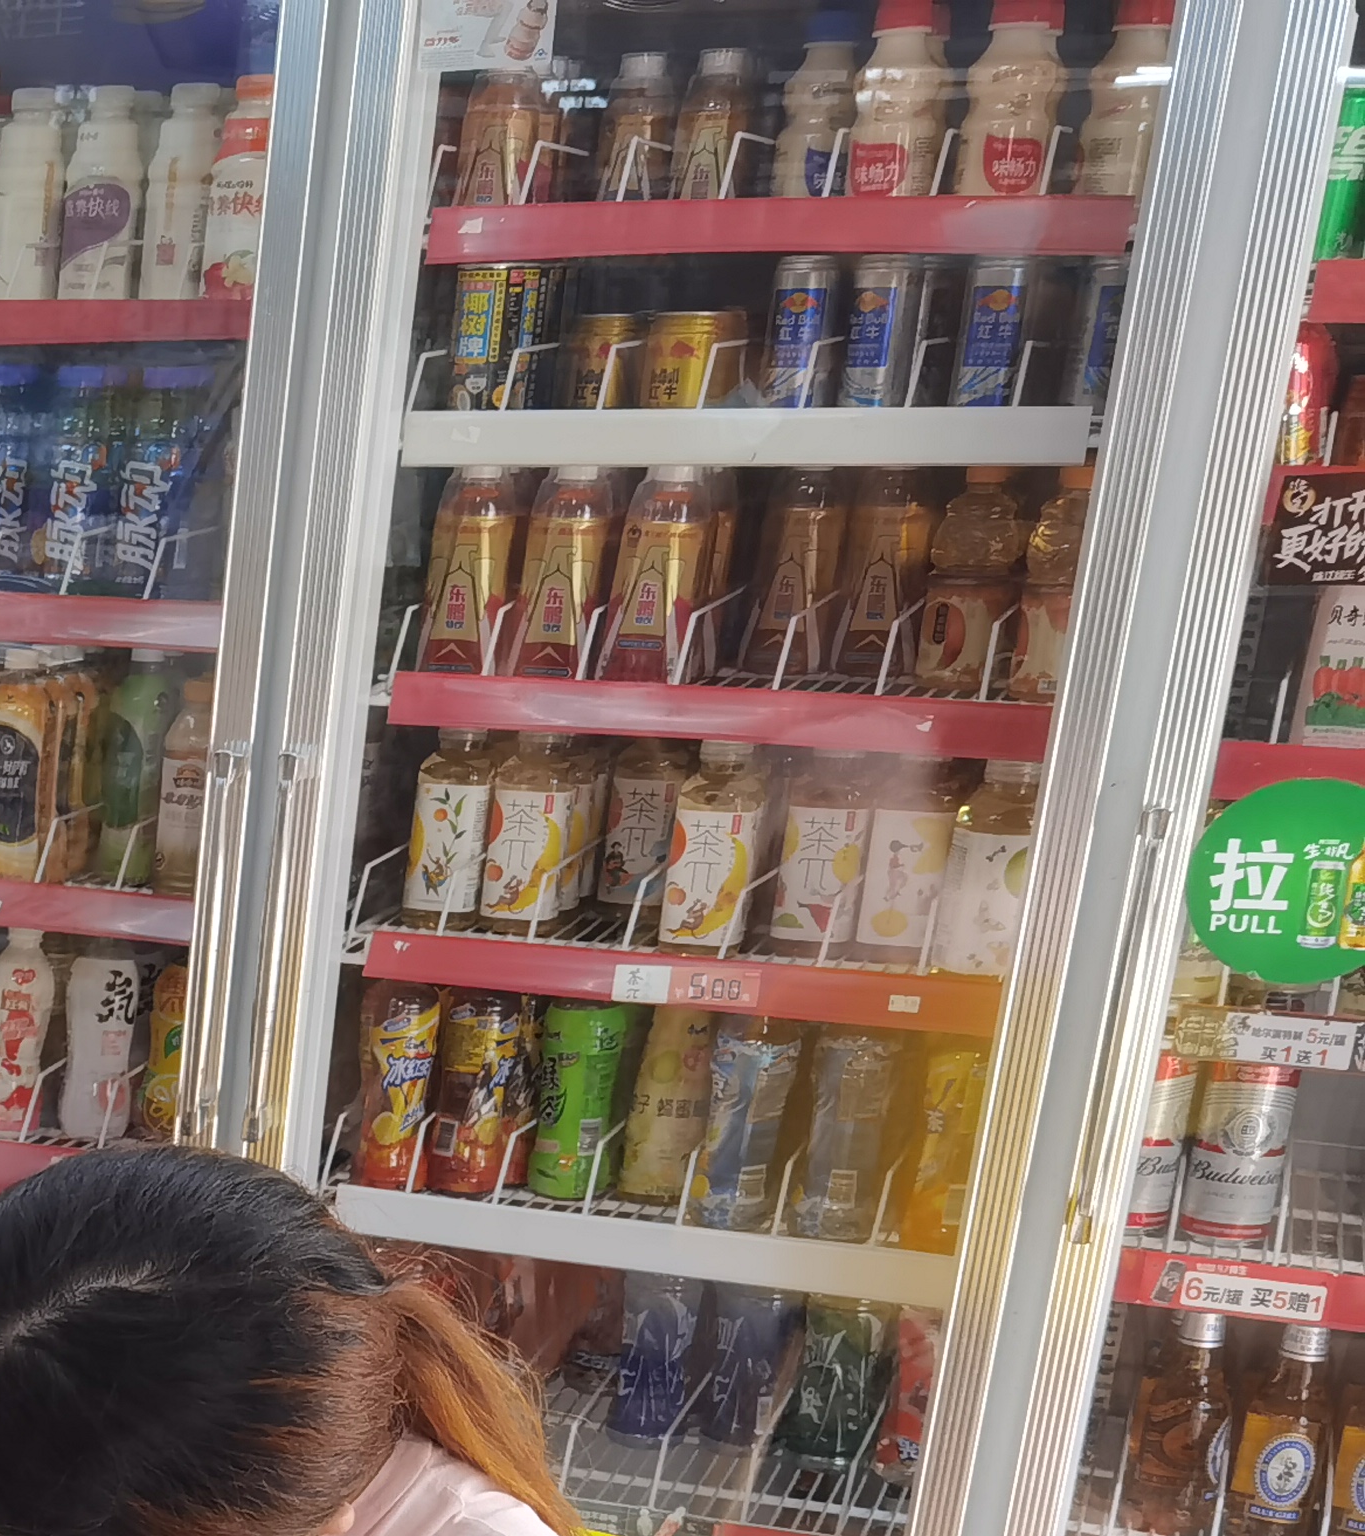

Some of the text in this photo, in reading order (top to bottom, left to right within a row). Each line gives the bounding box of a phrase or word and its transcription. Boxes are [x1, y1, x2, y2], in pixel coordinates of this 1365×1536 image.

[1209, 838, 1295, 912] 拉
[1209, 913, 1283, 935] PULL
[1259, 1045, 1329, 1066] 买1送1
[1250, 1286, 1323, 1314] 买5赠1
